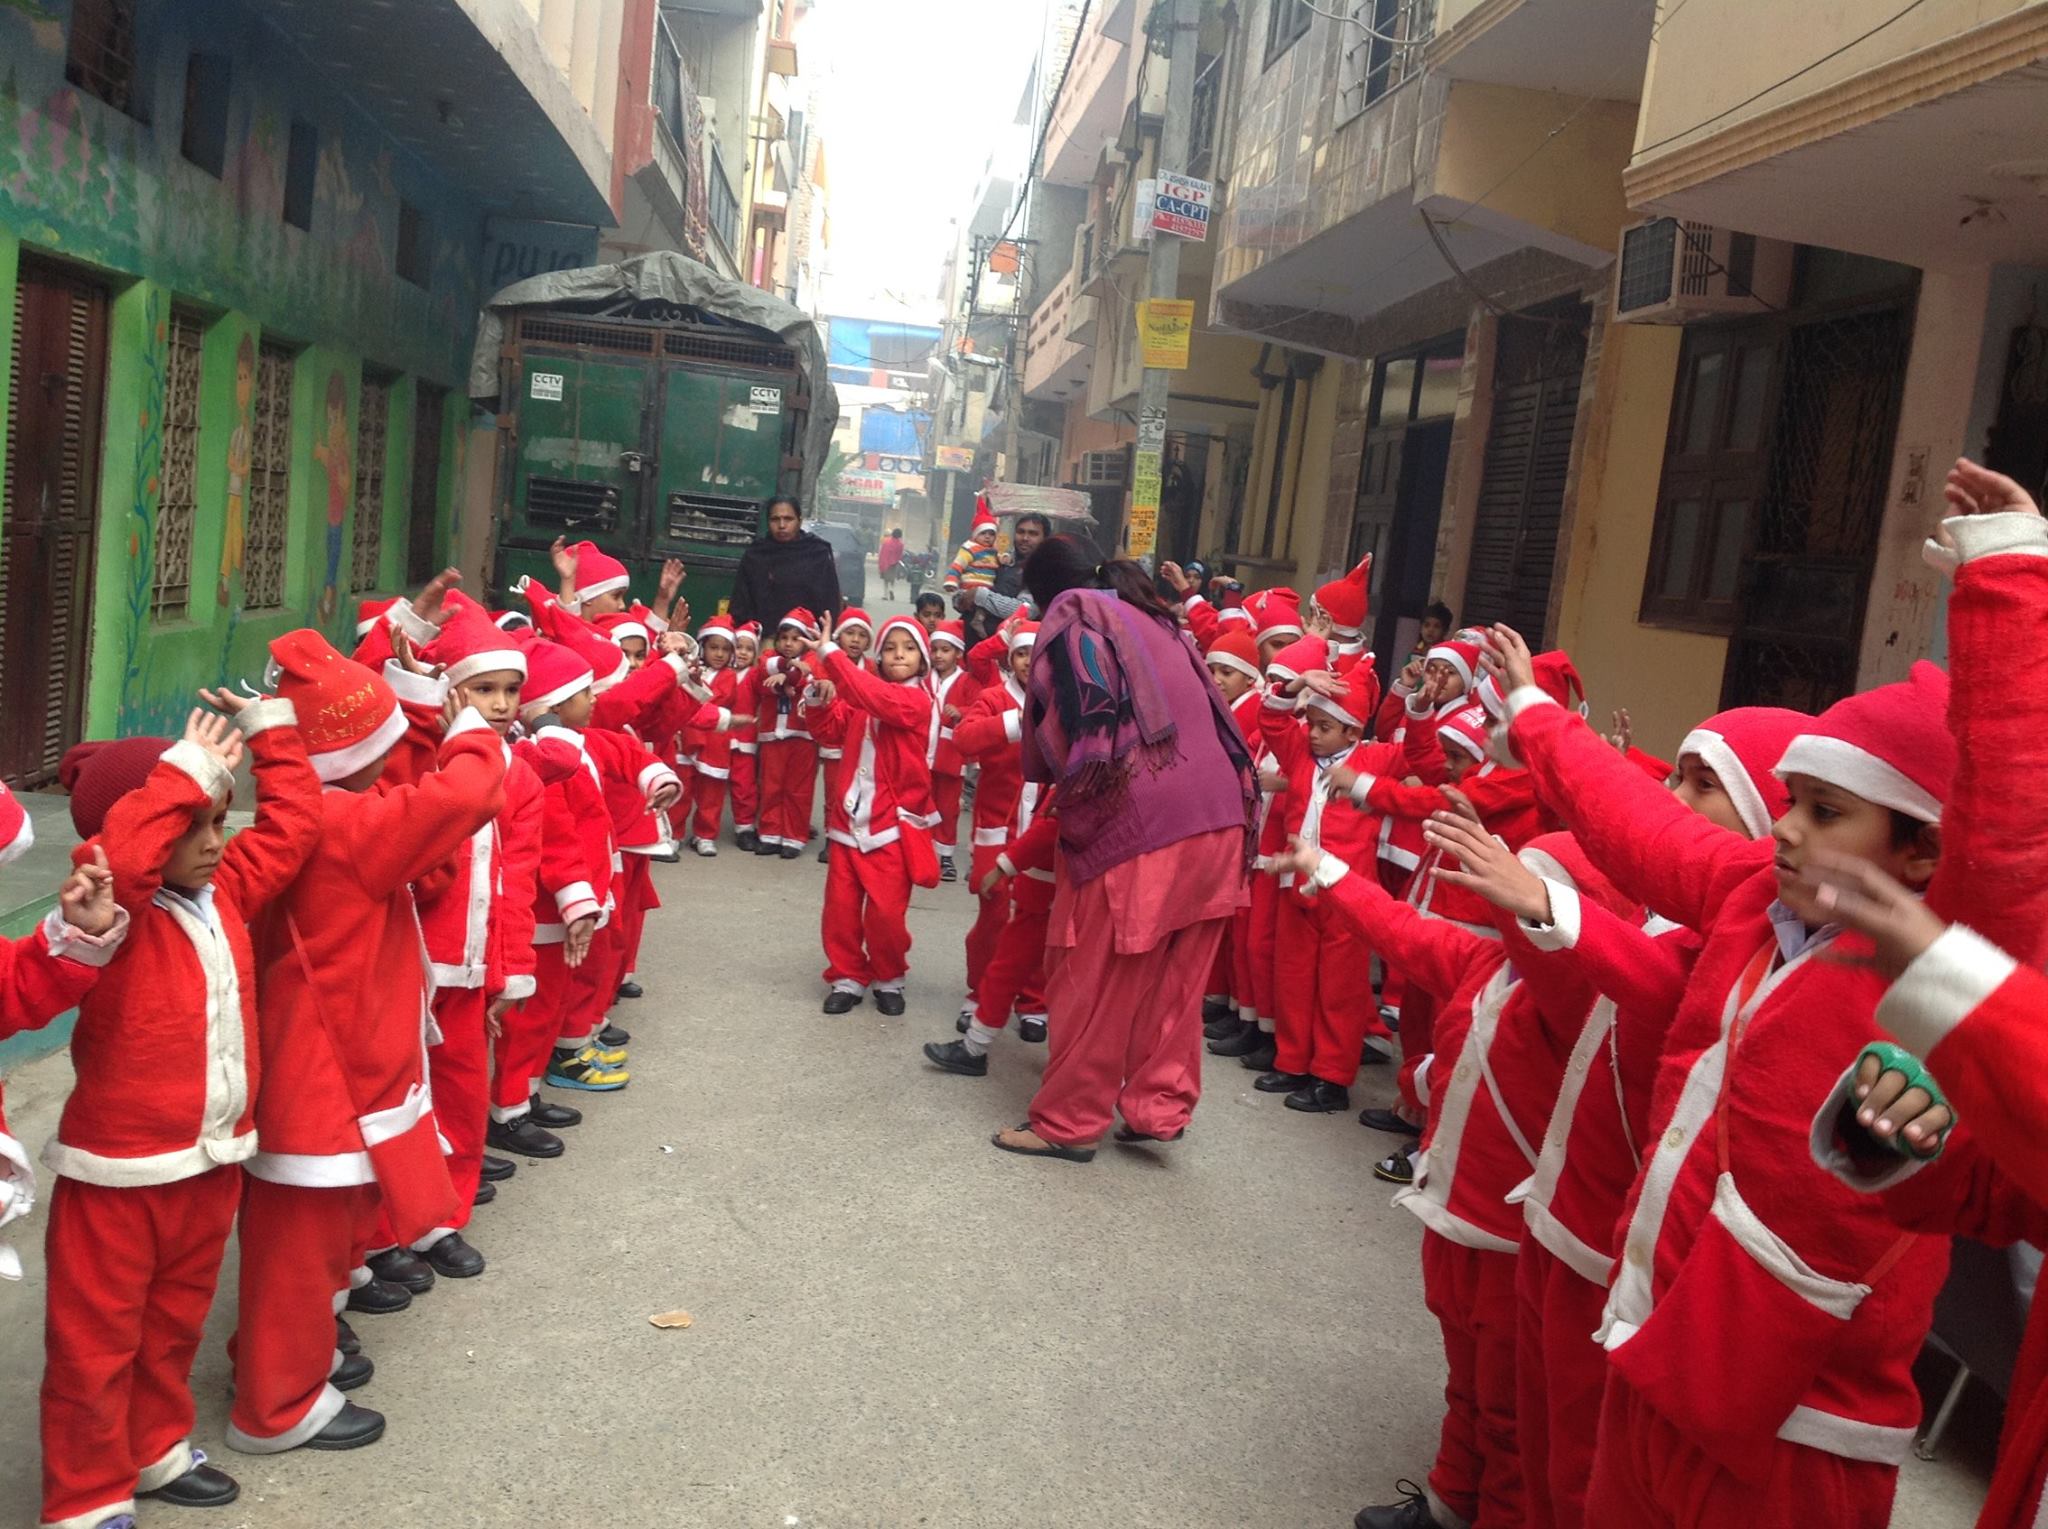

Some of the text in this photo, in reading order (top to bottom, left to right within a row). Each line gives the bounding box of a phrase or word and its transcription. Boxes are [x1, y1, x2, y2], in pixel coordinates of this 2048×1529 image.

[1163, 182, 1205, 202] IGP
[1156, 195, 1209, 219] CA-CPT
[534, 374, 562, 385] CCTV
[752, 388, 779, 398] CCTV
